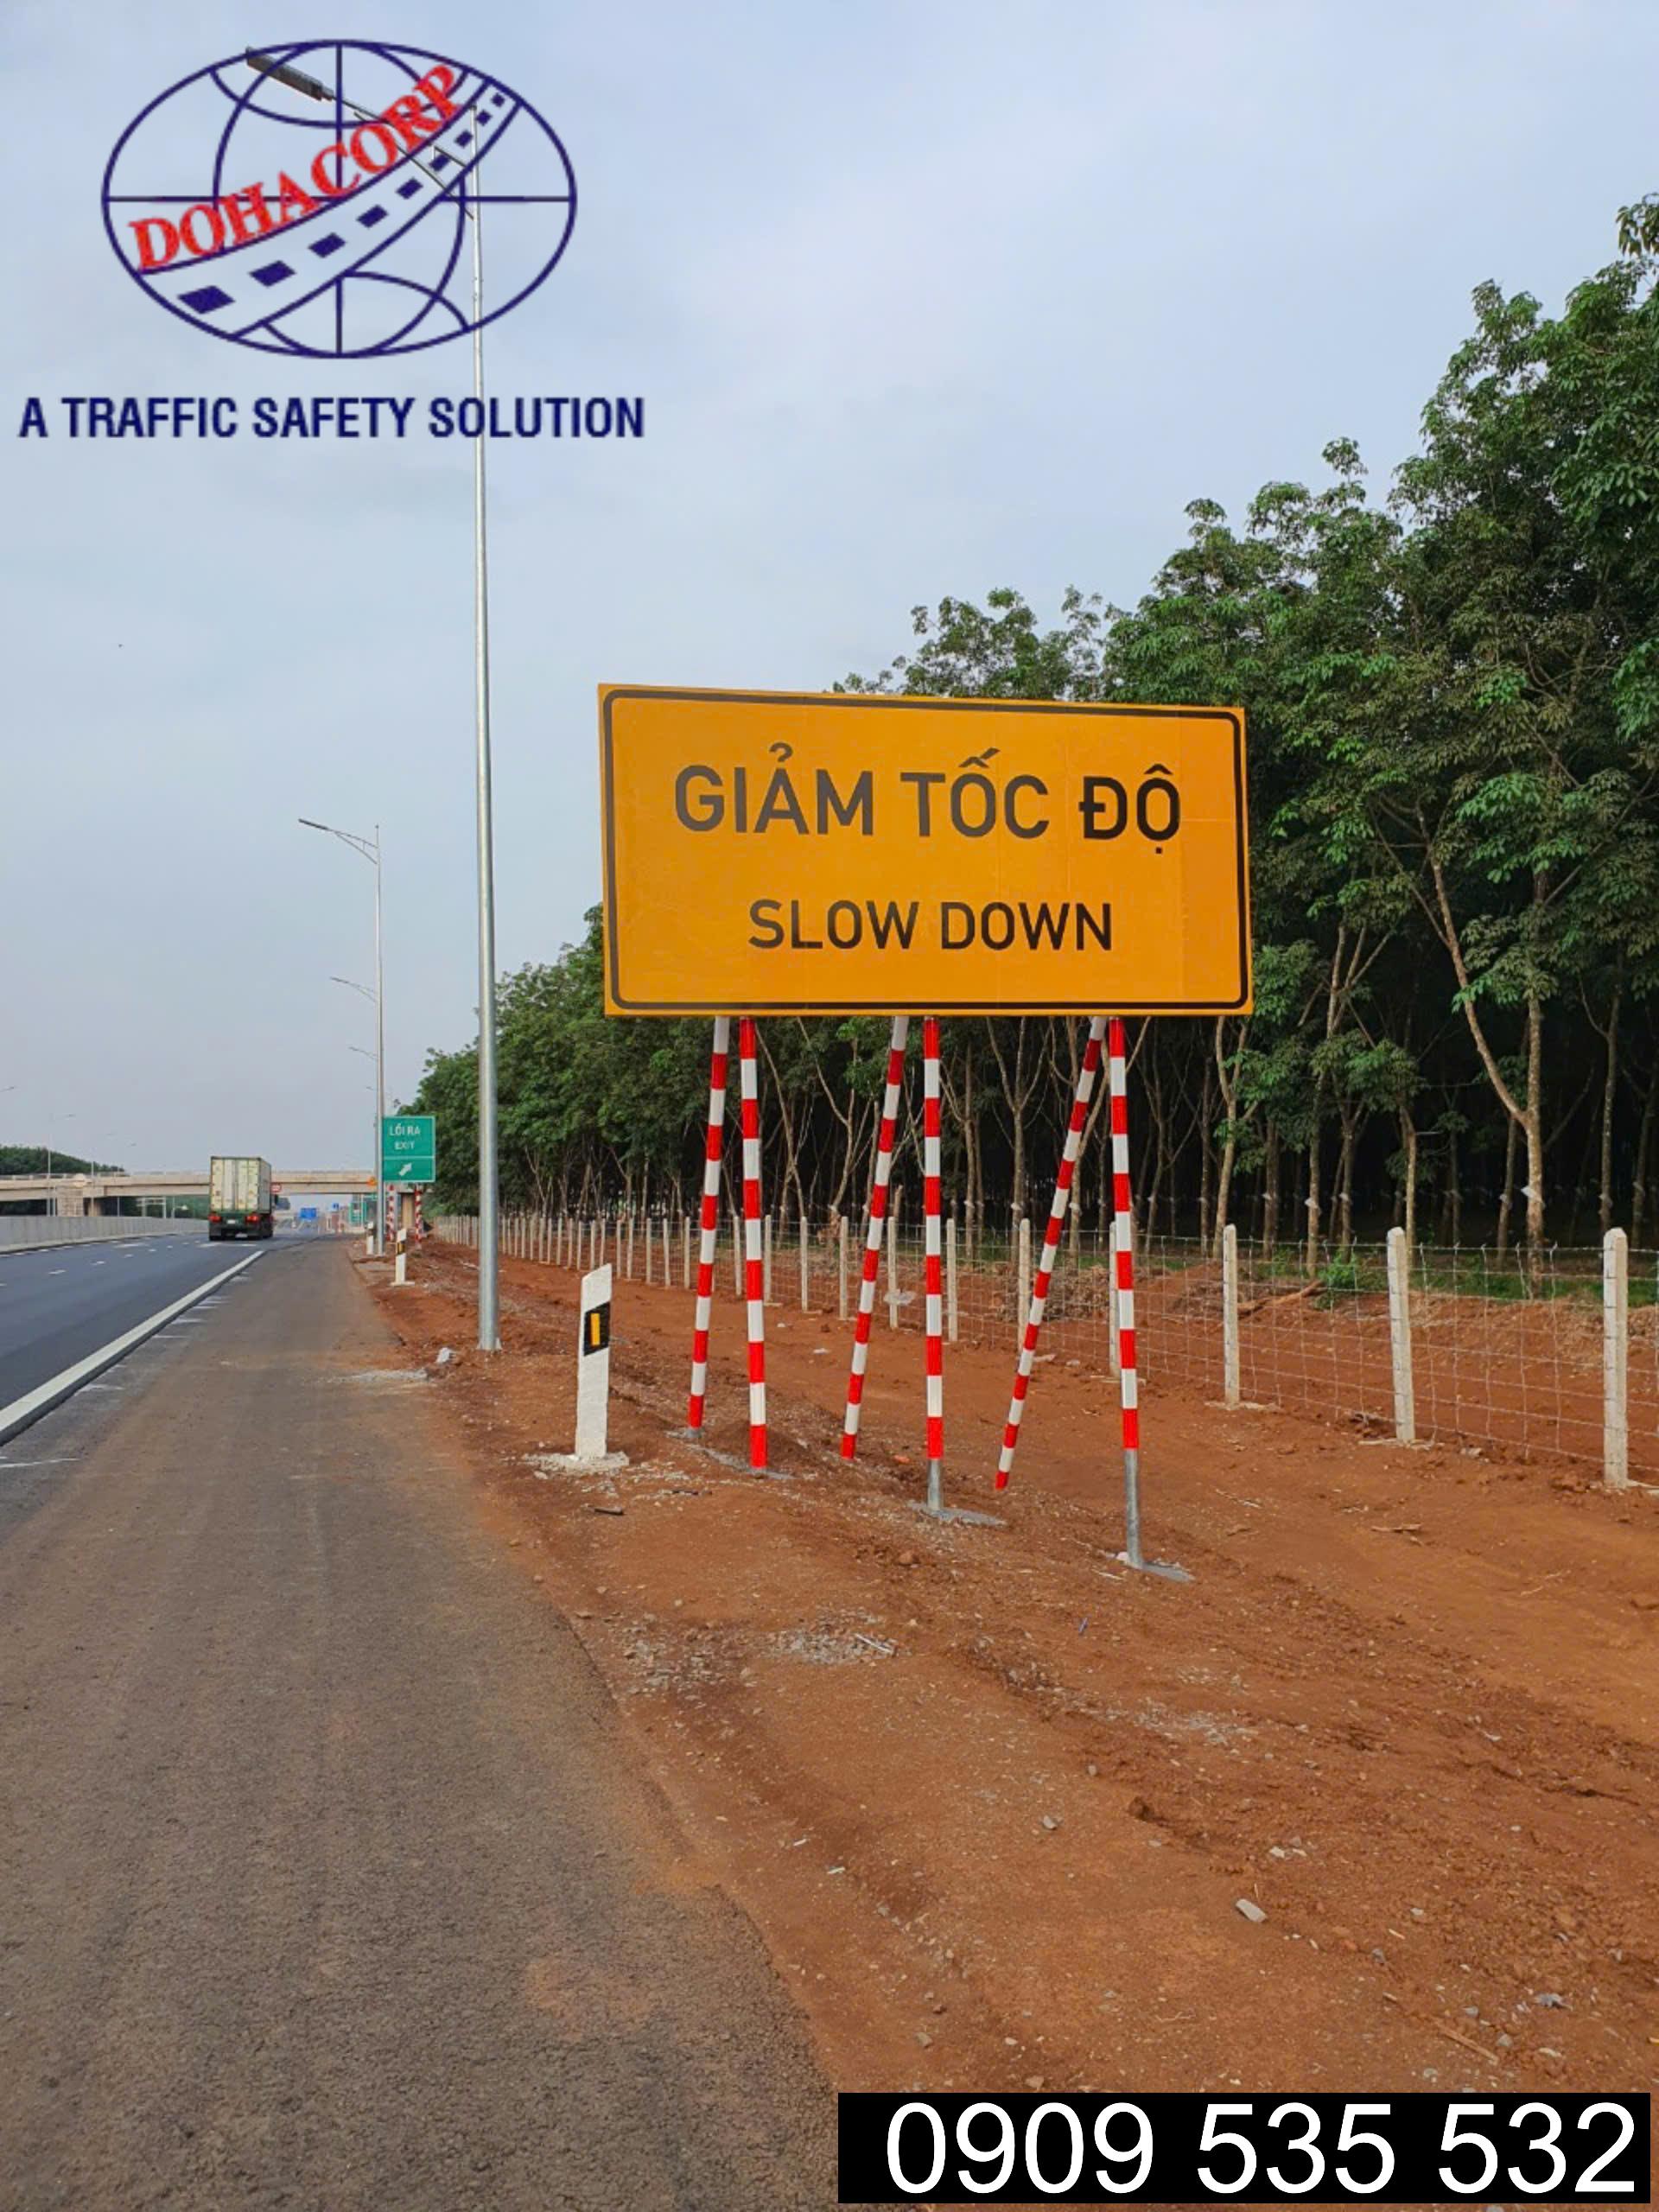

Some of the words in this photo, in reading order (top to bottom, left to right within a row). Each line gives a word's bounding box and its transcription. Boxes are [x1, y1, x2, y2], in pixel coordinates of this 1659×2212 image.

[674, 742, 874, 836] GIẢM
[900, 747, 1050, 839] TỐC
[1078, 763, 1181, 855] ĐỘ
[749, 899, 919, 950] SLOW
[941, 901, 1113, 951] DOWN
[394, 1141, 415, 1150] EXIT
[407, 1126, 422, 1136] RA
